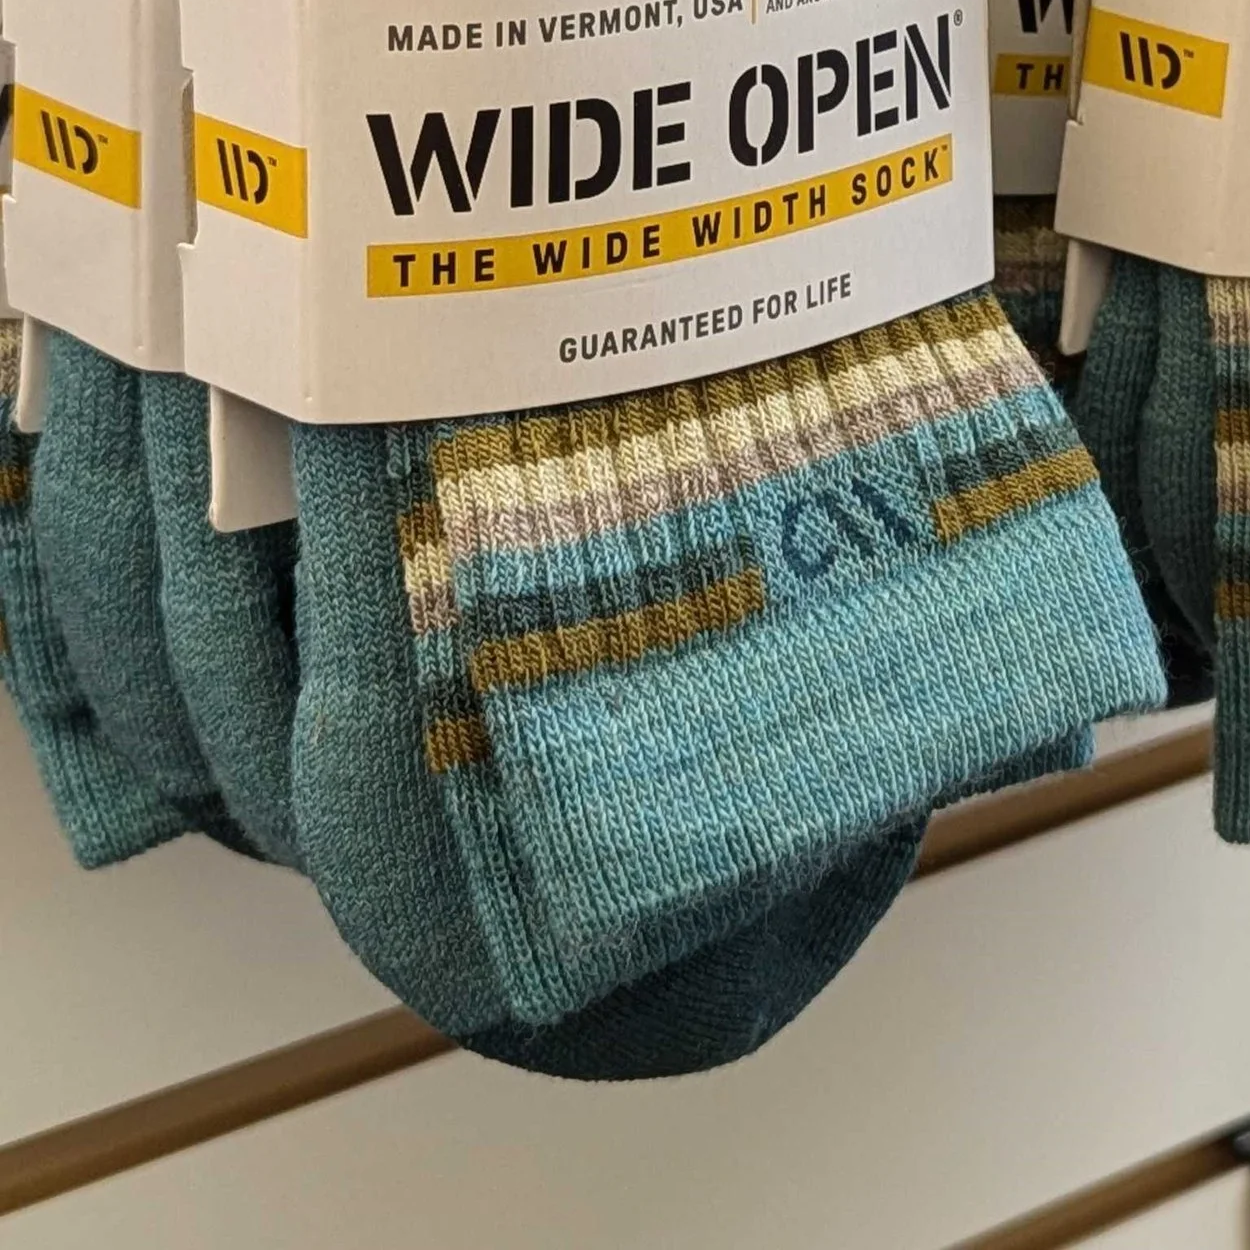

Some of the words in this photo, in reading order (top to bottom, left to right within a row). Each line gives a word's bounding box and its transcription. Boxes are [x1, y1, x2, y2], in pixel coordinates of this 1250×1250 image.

[387, 23, 483, 52] MADE
[496, 20, 526, 48] IN
[1015, 63, 1064, 90] TH
[366, 81, 692, 216] WIDE
[393, 248, 495, 288] THE
[532, 224, 661, 277] WIDE
[692, 183, 826, 249] WIDTH
[559, 305, 743, 364] GUARANTEED
[752, 291, 798, 326] FOR
[805, 272, 852, 309] LIFE
